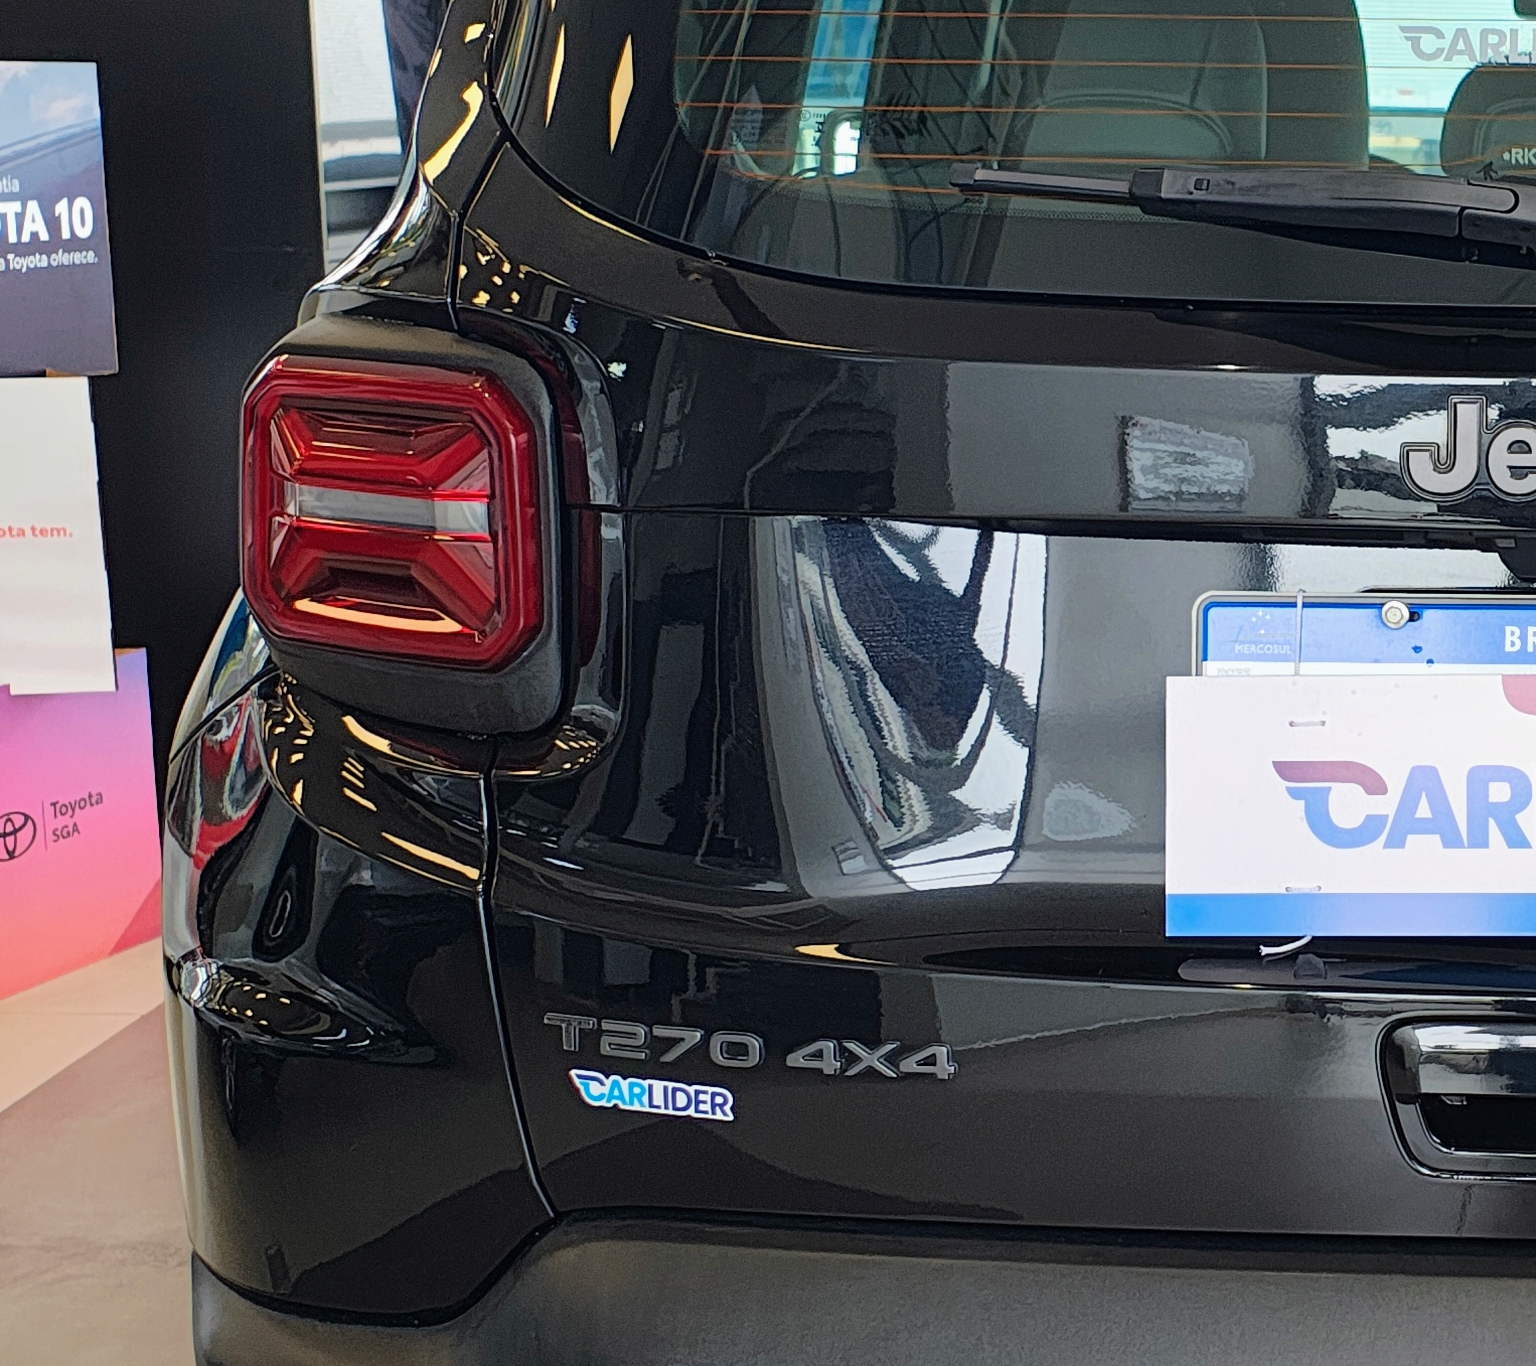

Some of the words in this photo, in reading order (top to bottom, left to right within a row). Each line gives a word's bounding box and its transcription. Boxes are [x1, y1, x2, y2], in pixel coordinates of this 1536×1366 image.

[54, 196, 94, 240] 10
[7, 252, 48, 274] Toyota
[50, 248, 99, 267] oferece.
[30, 524, 73, 538] tem.
[1234, 643, 1293, 654] MERCOSUL
[50, 791, 103, 819] Toyota
[52, 821, 80, 843] SGA
[543, 1011, 766, 1069] T270
[575, 1073, 730, 1118] CARLIDER
